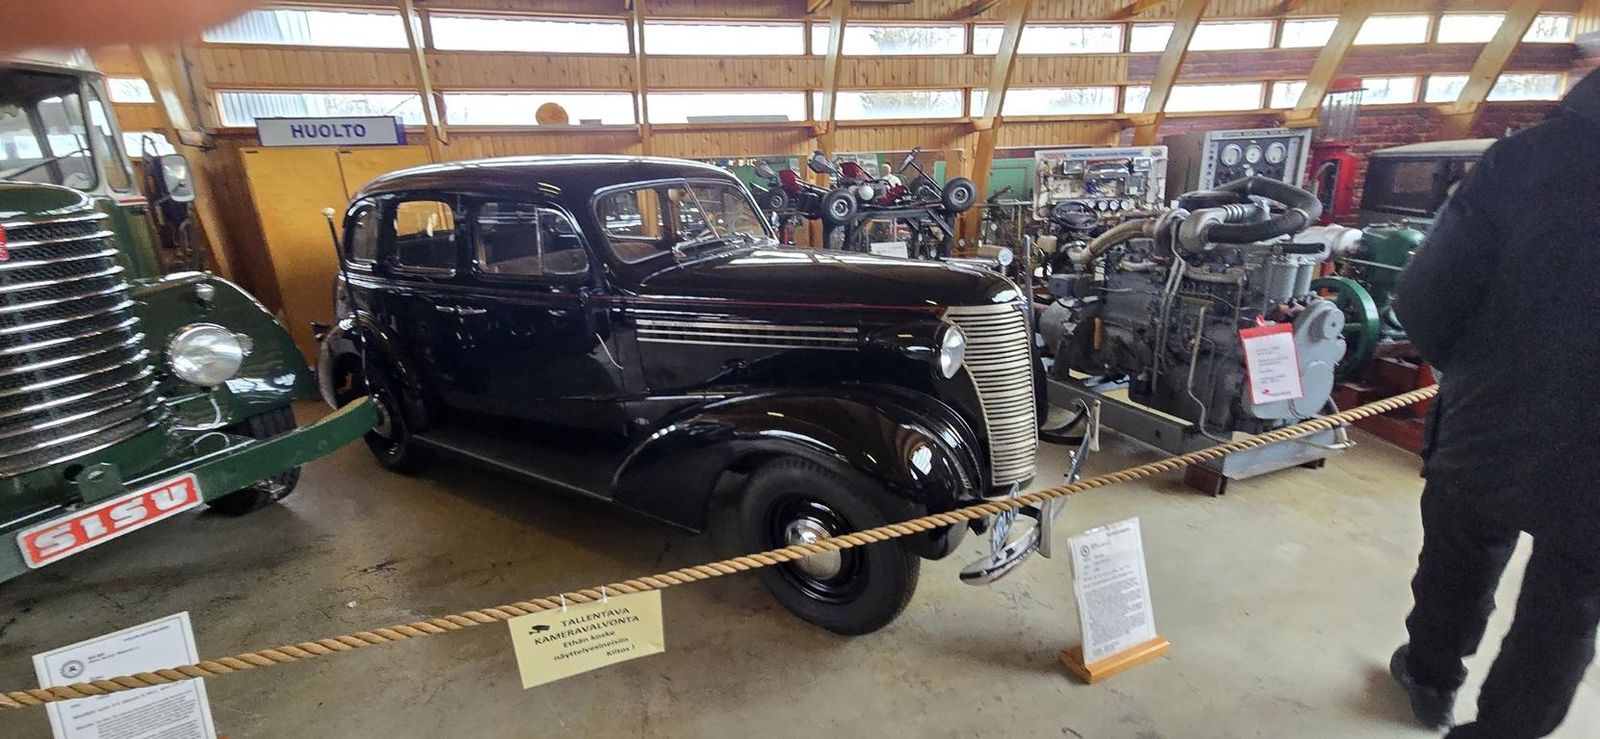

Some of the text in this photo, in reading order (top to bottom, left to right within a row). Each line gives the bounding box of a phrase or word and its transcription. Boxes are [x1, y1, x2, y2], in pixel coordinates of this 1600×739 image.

[290, 124, 366, 139] HUOLTO
[34, 484, 188, 557] SISU
[560, 607, 630, 628] TALLENTAVA
[534, 615, 640, 646] KAMERAVALVONTA
[563, 630, 616, 648] Ethän koske
[606, 647, 630, 658] Kiitos
